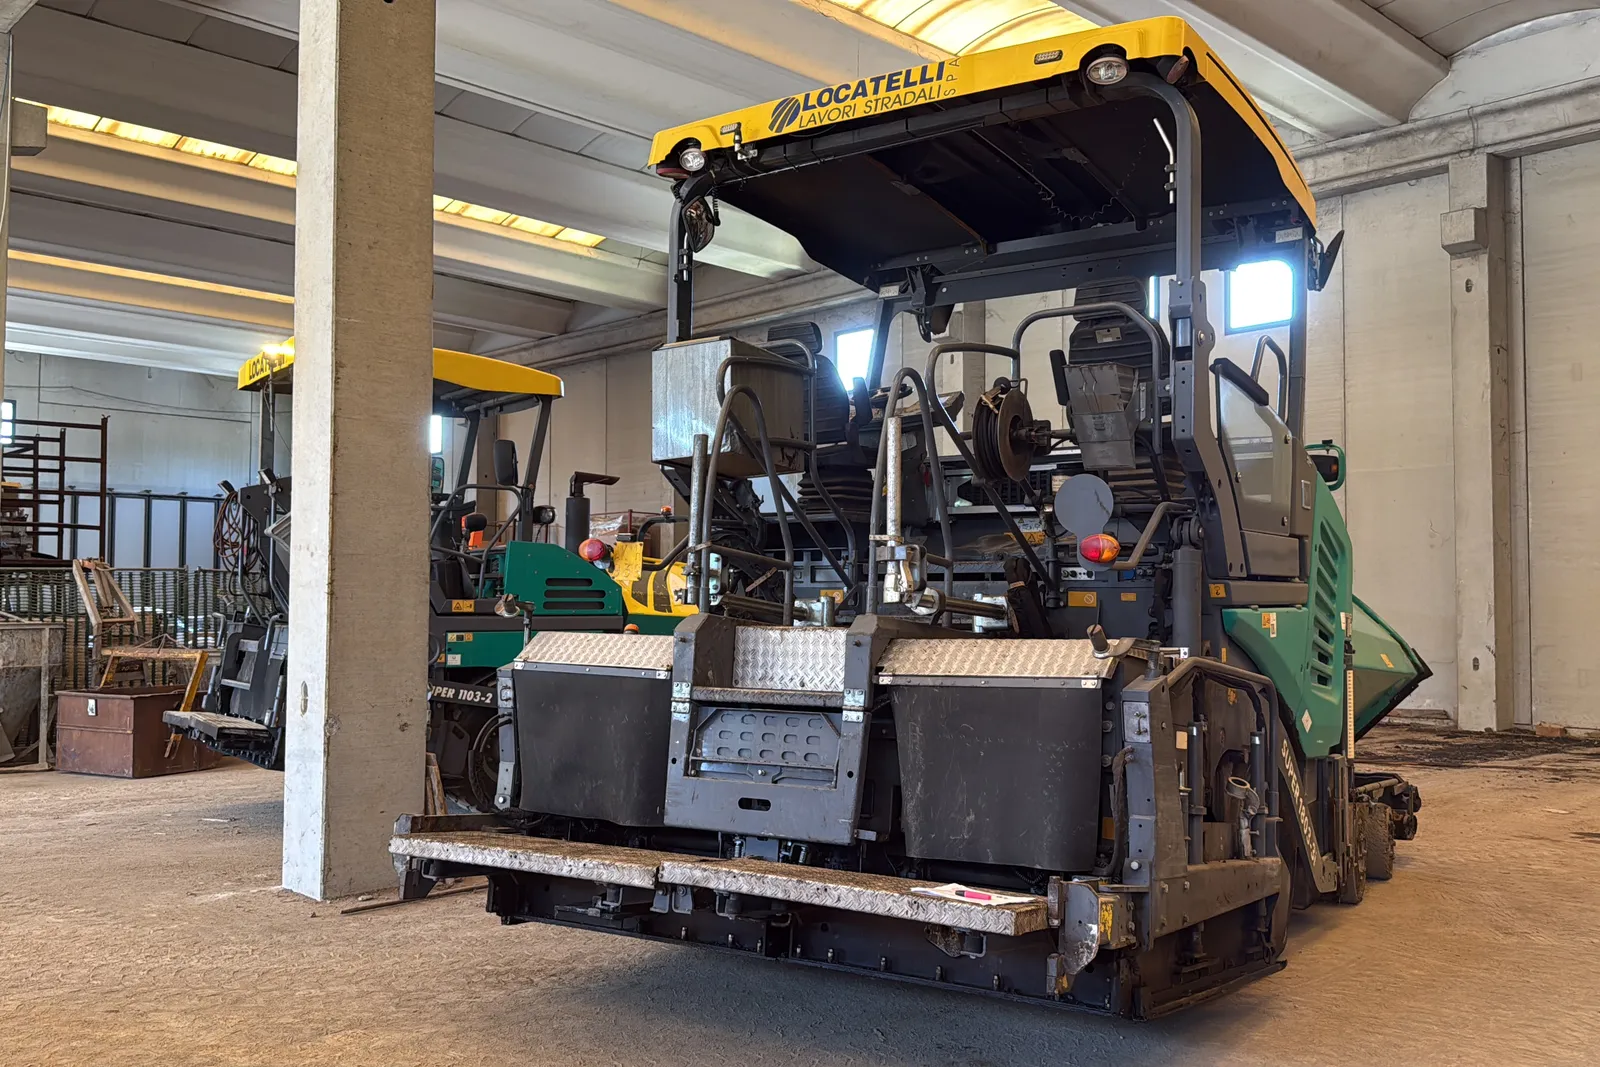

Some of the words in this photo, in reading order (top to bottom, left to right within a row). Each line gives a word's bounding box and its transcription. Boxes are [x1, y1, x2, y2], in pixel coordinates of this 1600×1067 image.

[799, 104, 856, 129] LAVORI
[863, 84, 942, 115] STRADALI
[802, 61, 946, 112] LOCATELLI
[457, 689, 493, 704] 1103-2
[1281, 739, 1300, 805] SUPER
